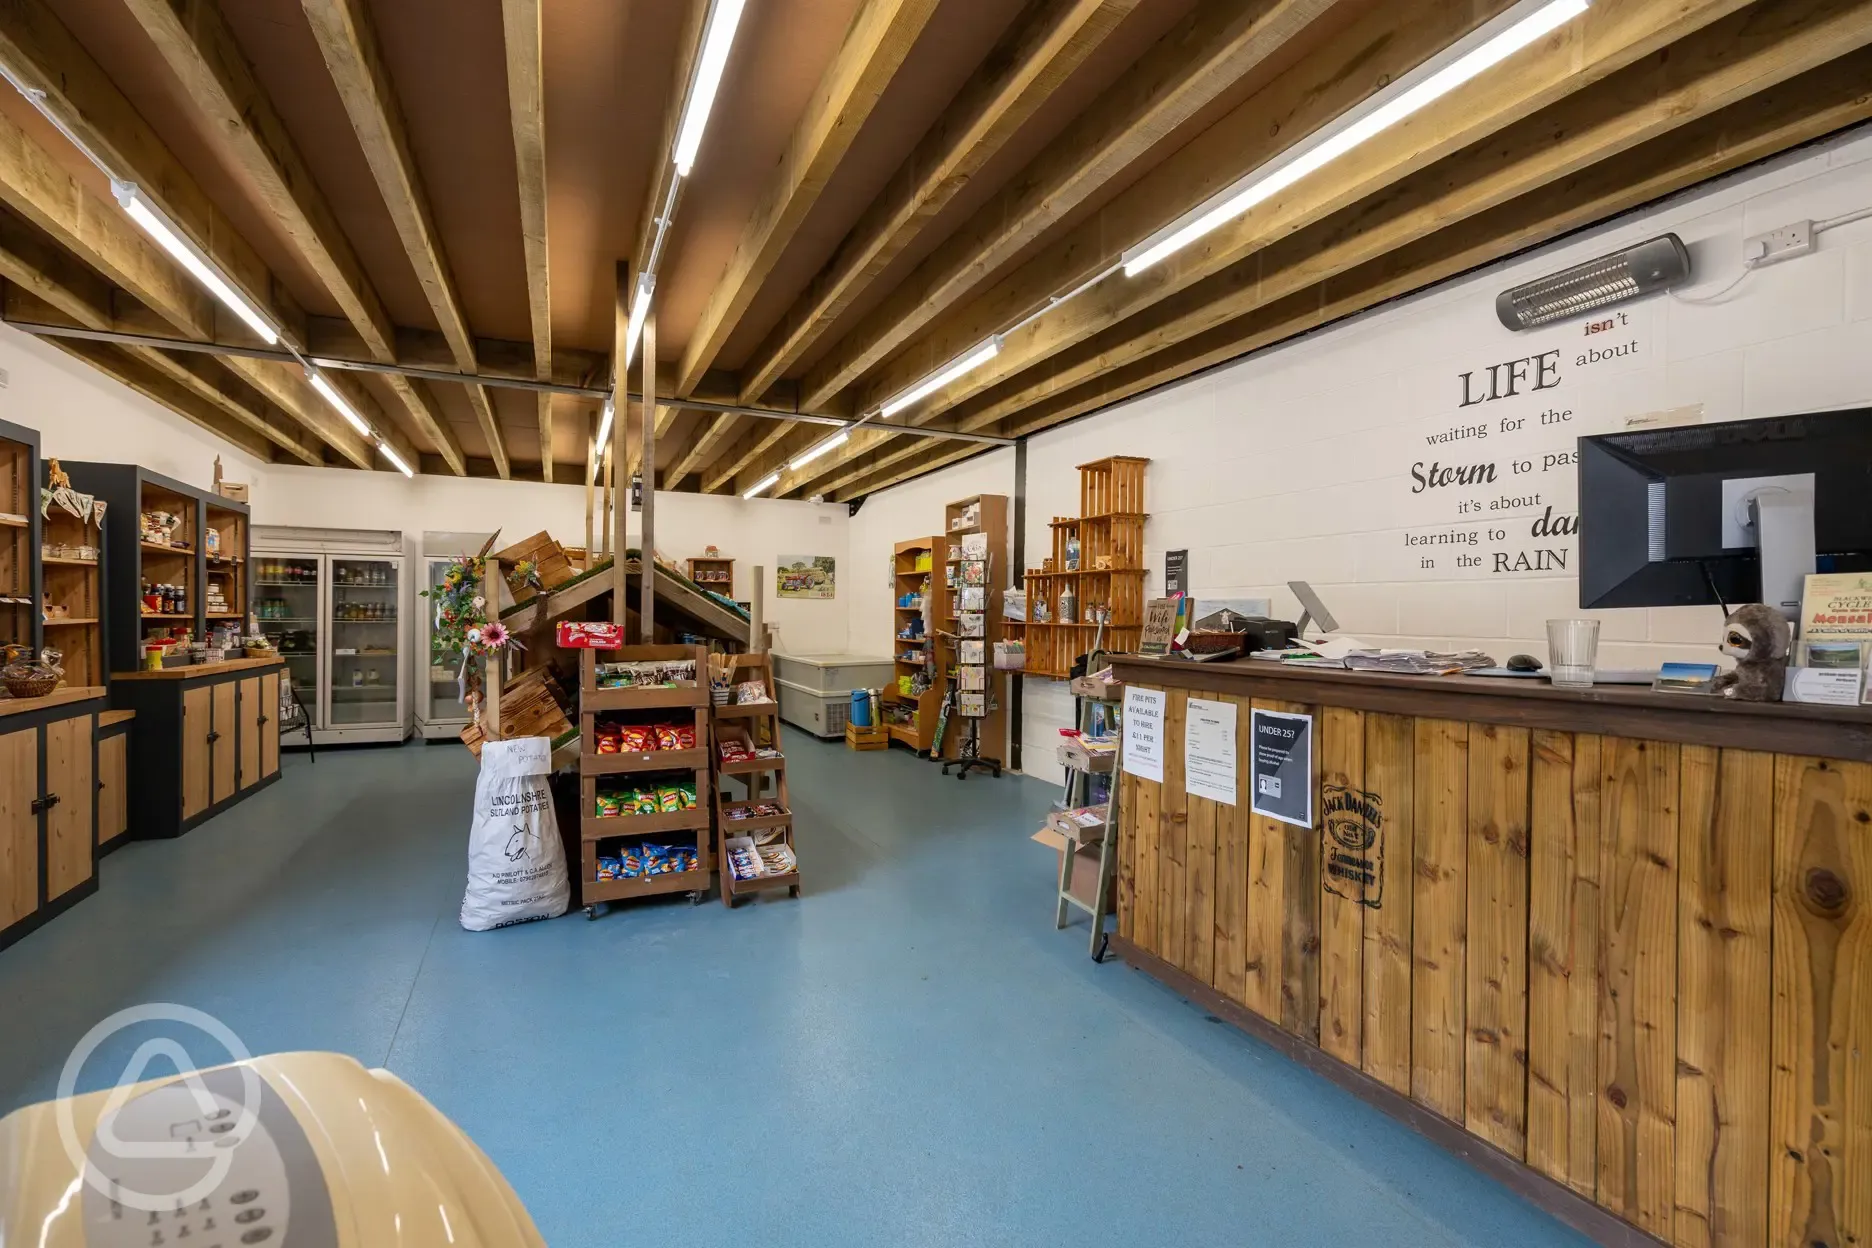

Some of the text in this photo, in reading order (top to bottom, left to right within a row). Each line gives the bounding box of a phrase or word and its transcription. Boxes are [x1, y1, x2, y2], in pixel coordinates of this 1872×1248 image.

[1584, 312, 1628, 336] isn't
[1458, 340, 1639, 408] LIFE about
[1426, 408, 1573, 447] waiting for the
[1411, 461, 1498, 494] Storm
[1512, 460, 1532, 475] to
[1458, 492, 1542, 514] it's about
[1404, 530, 1479, 547] learning
[1488, 527, 1506, 541] to
[1420, 548, 1569, 573] in the RAIN
[1828, 601, 1871, 609] CYCLE
[1132, 693, 1157, 705] FIRE PITS
[1128, 706, 1159, 718] AVAILABLE
[1133, 719, 1153, 730] TO HIRE
[1258, 724, 1295, 739] UNDER 25?
[1143, 734, 1154, 743] PER
[491, 789, 547, 806] LINCOLNSHRE
[1323, 796, 1344, 816] JACK
[521, 801, 550, 814] POTATES
